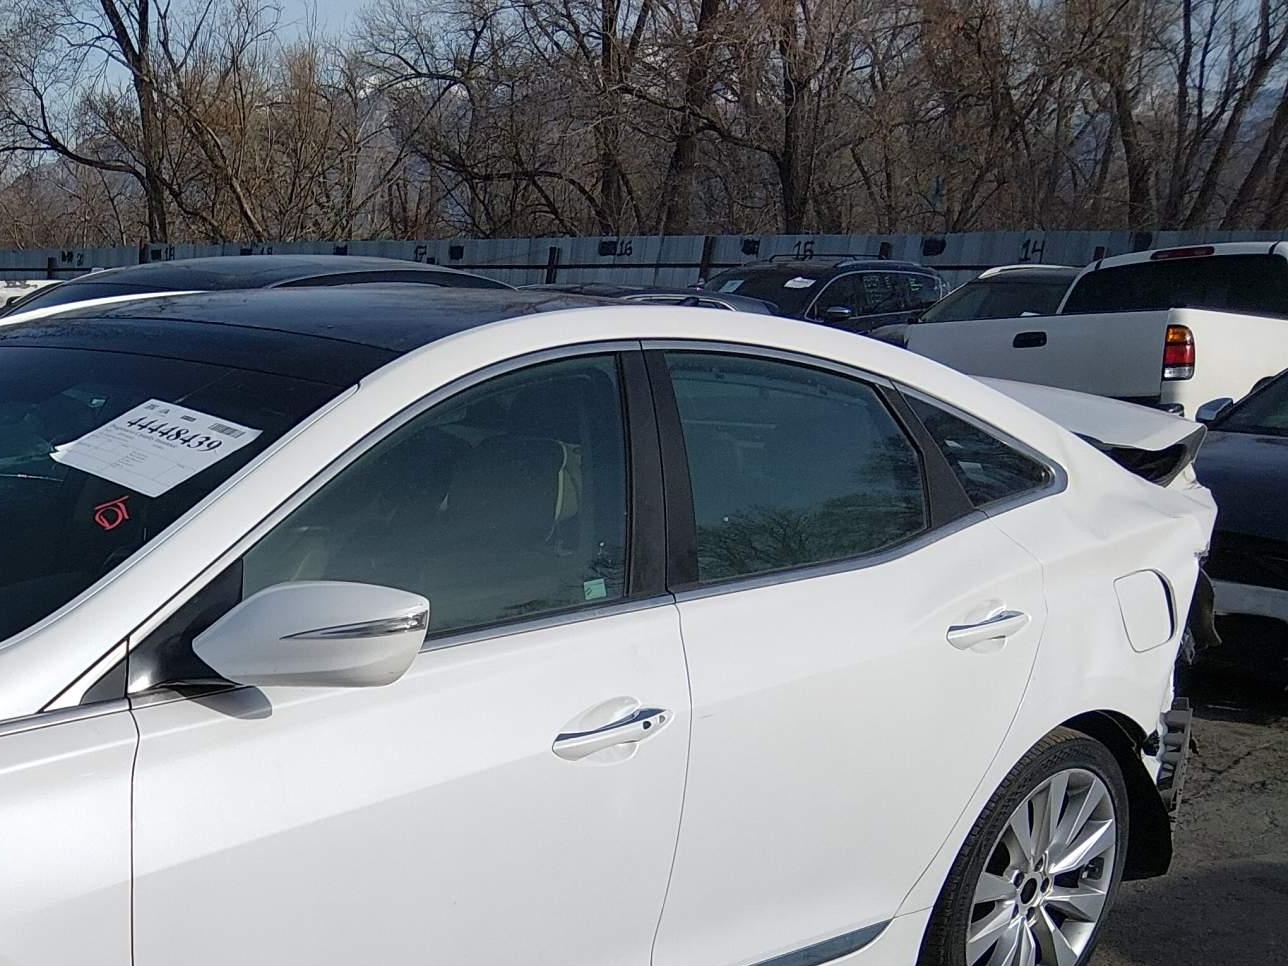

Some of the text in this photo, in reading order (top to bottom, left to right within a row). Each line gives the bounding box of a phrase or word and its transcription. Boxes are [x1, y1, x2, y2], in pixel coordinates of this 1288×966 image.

[617, 239, 633, 257] 16
[793, 241, 815, 262] 15
[1019, 239, 1046, 265] 14
[127, 416, 223, 452] 44448439
